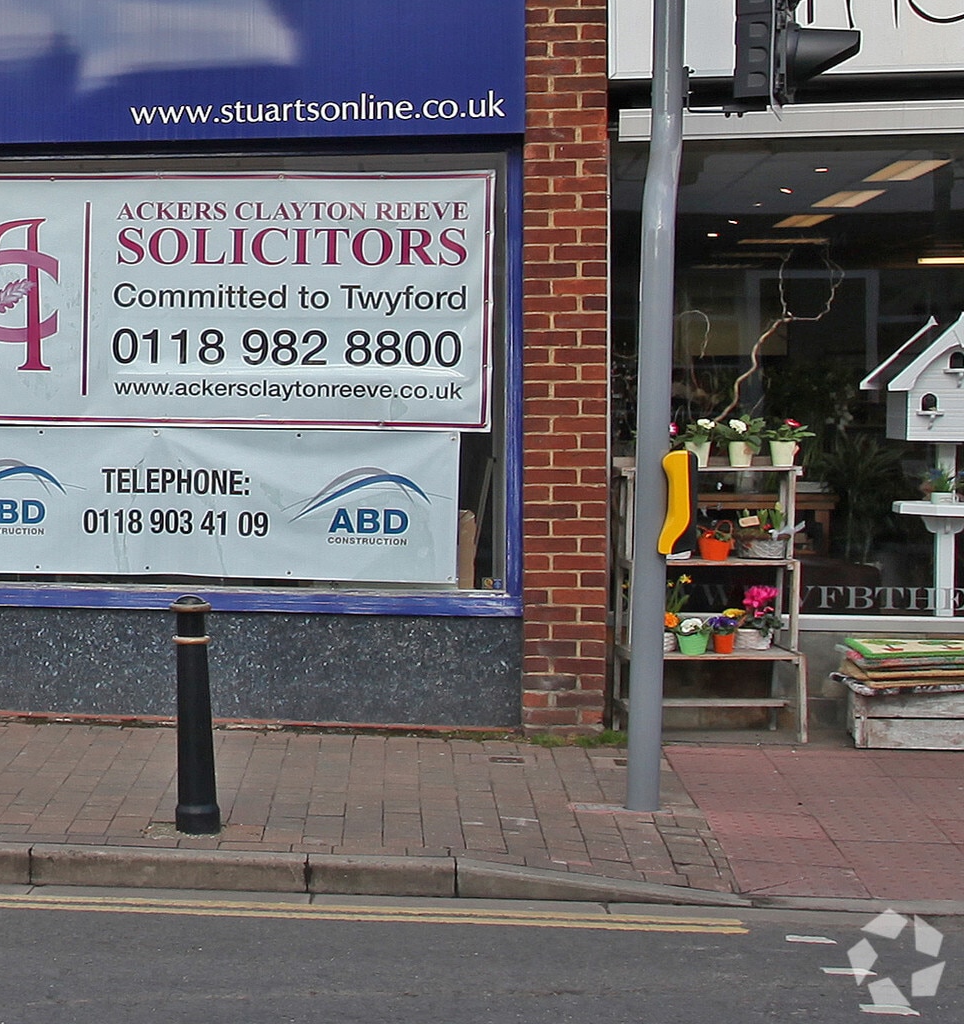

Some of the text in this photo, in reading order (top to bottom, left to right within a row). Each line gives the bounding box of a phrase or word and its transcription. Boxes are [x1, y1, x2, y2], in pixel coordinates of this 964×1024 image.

[131, 90, 506, 125] www.stuartsonline.co.uk
[117, 202, 469, 220] ACKERS CLAYTON REEVE
[117, 227, 468, 266] SOLICITORS
[113, 282, 468, 316] Committed to Twyford
[112, 328, 462, 367] 0118 982 8800
[114, 378, 463, 401] www.ackersclaytonreeve.co.uk
[101, 468, 250, 496] TELEPHONE:
[83, 509, 269, 537] 0118 903 41 09
[328, 508, 409, 534] ABD
[327, 537, 407, 546] CONSTRUCTION
